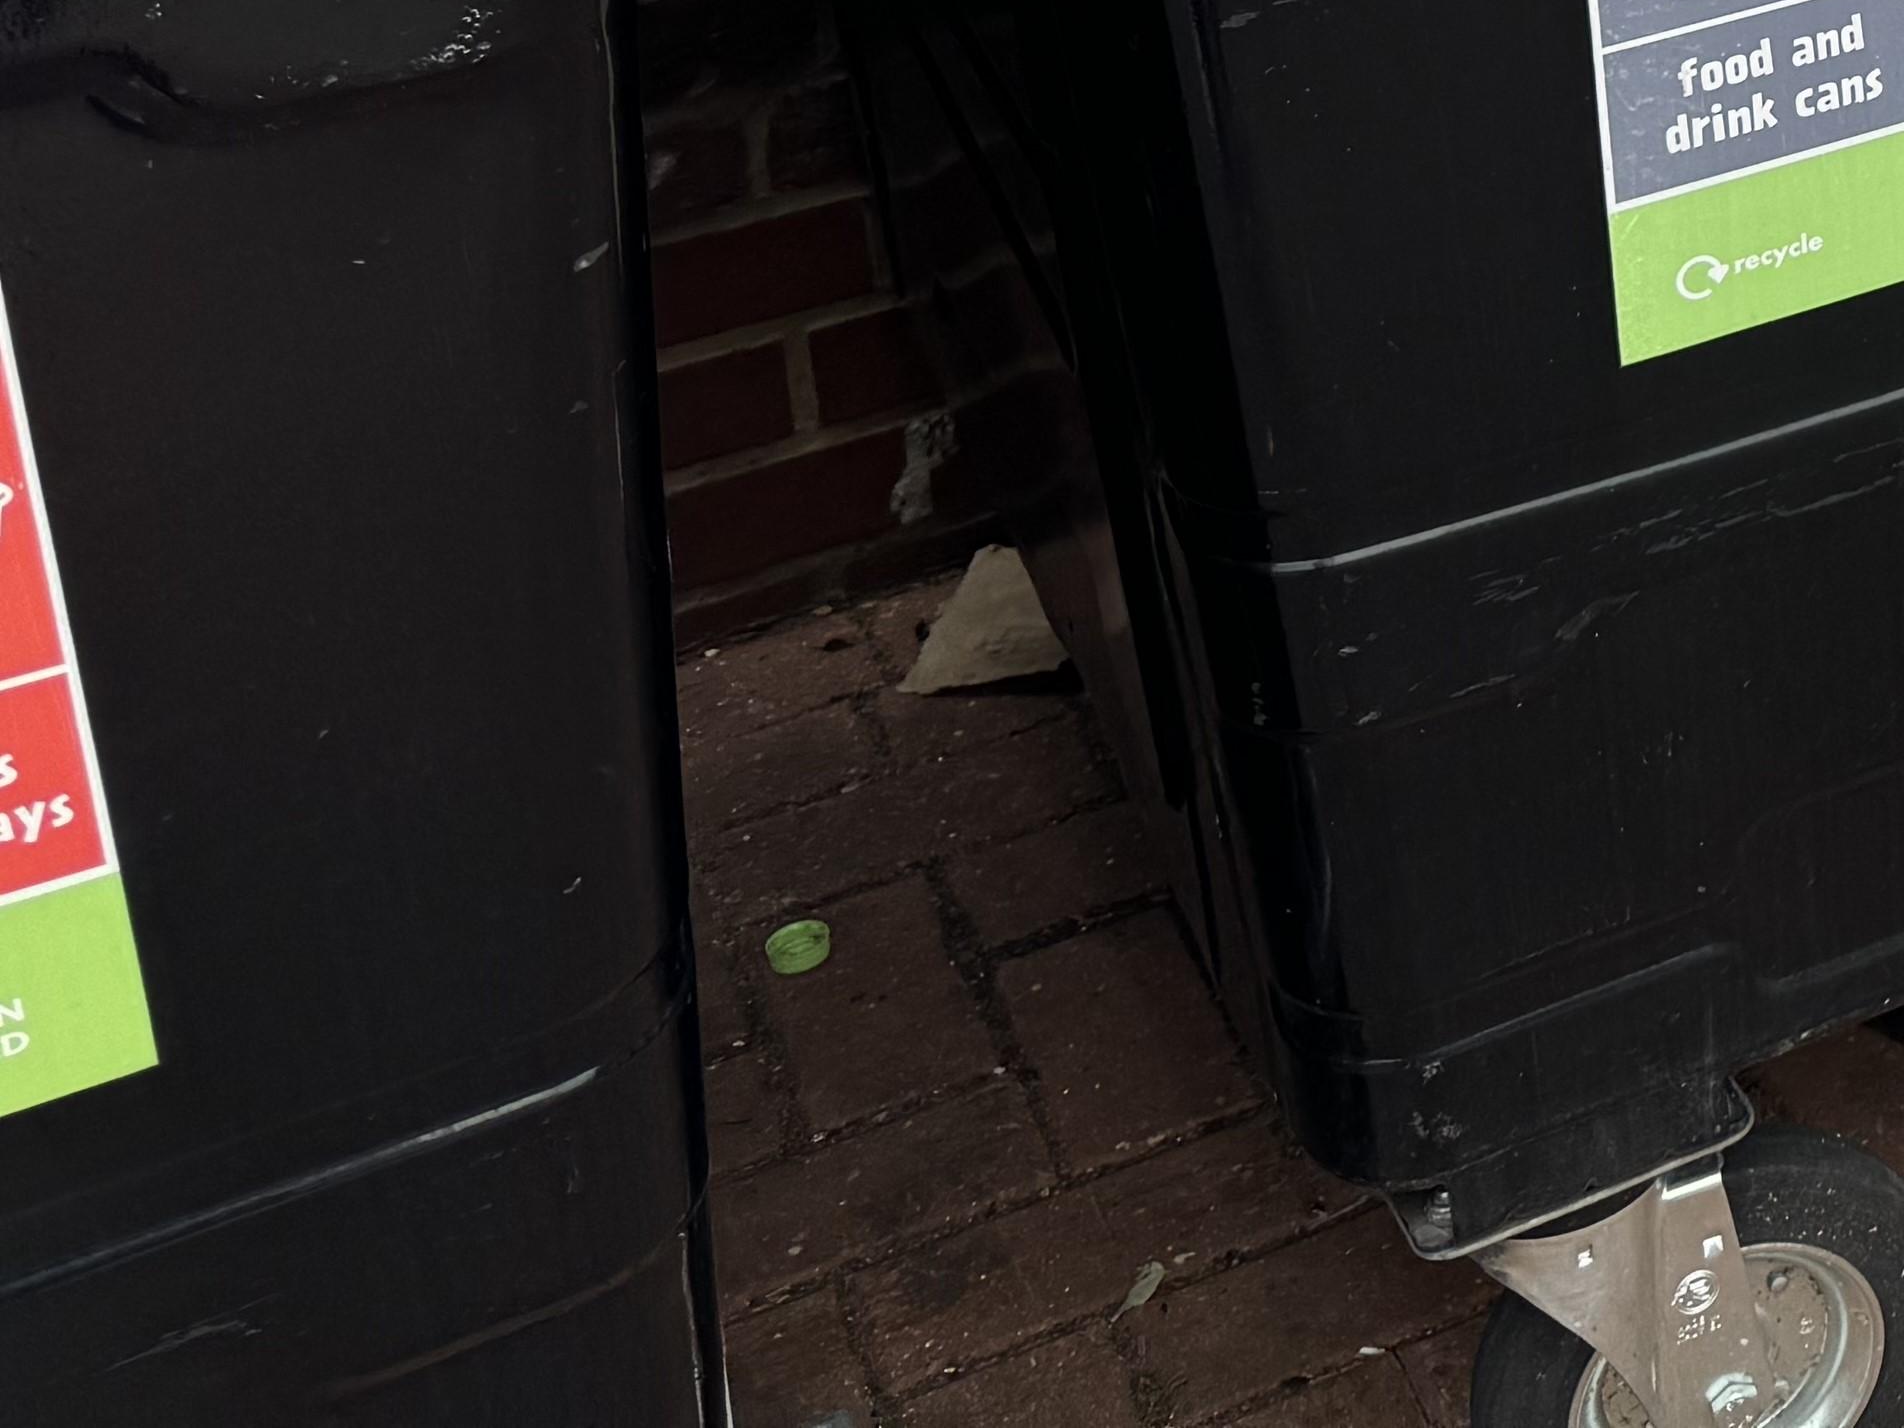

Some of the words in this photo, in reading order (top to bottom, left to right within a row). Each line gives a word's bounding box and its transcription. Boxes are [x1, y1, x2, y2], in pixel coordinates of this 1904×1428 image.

[1677, 37, 1774, 98] food
[1792, 13, 1865, 67] and
[1666, 92, 1778, 154] drink
[1795, 68, 1884, 118] cans
[1734, 233, 1824, 274] recycle
